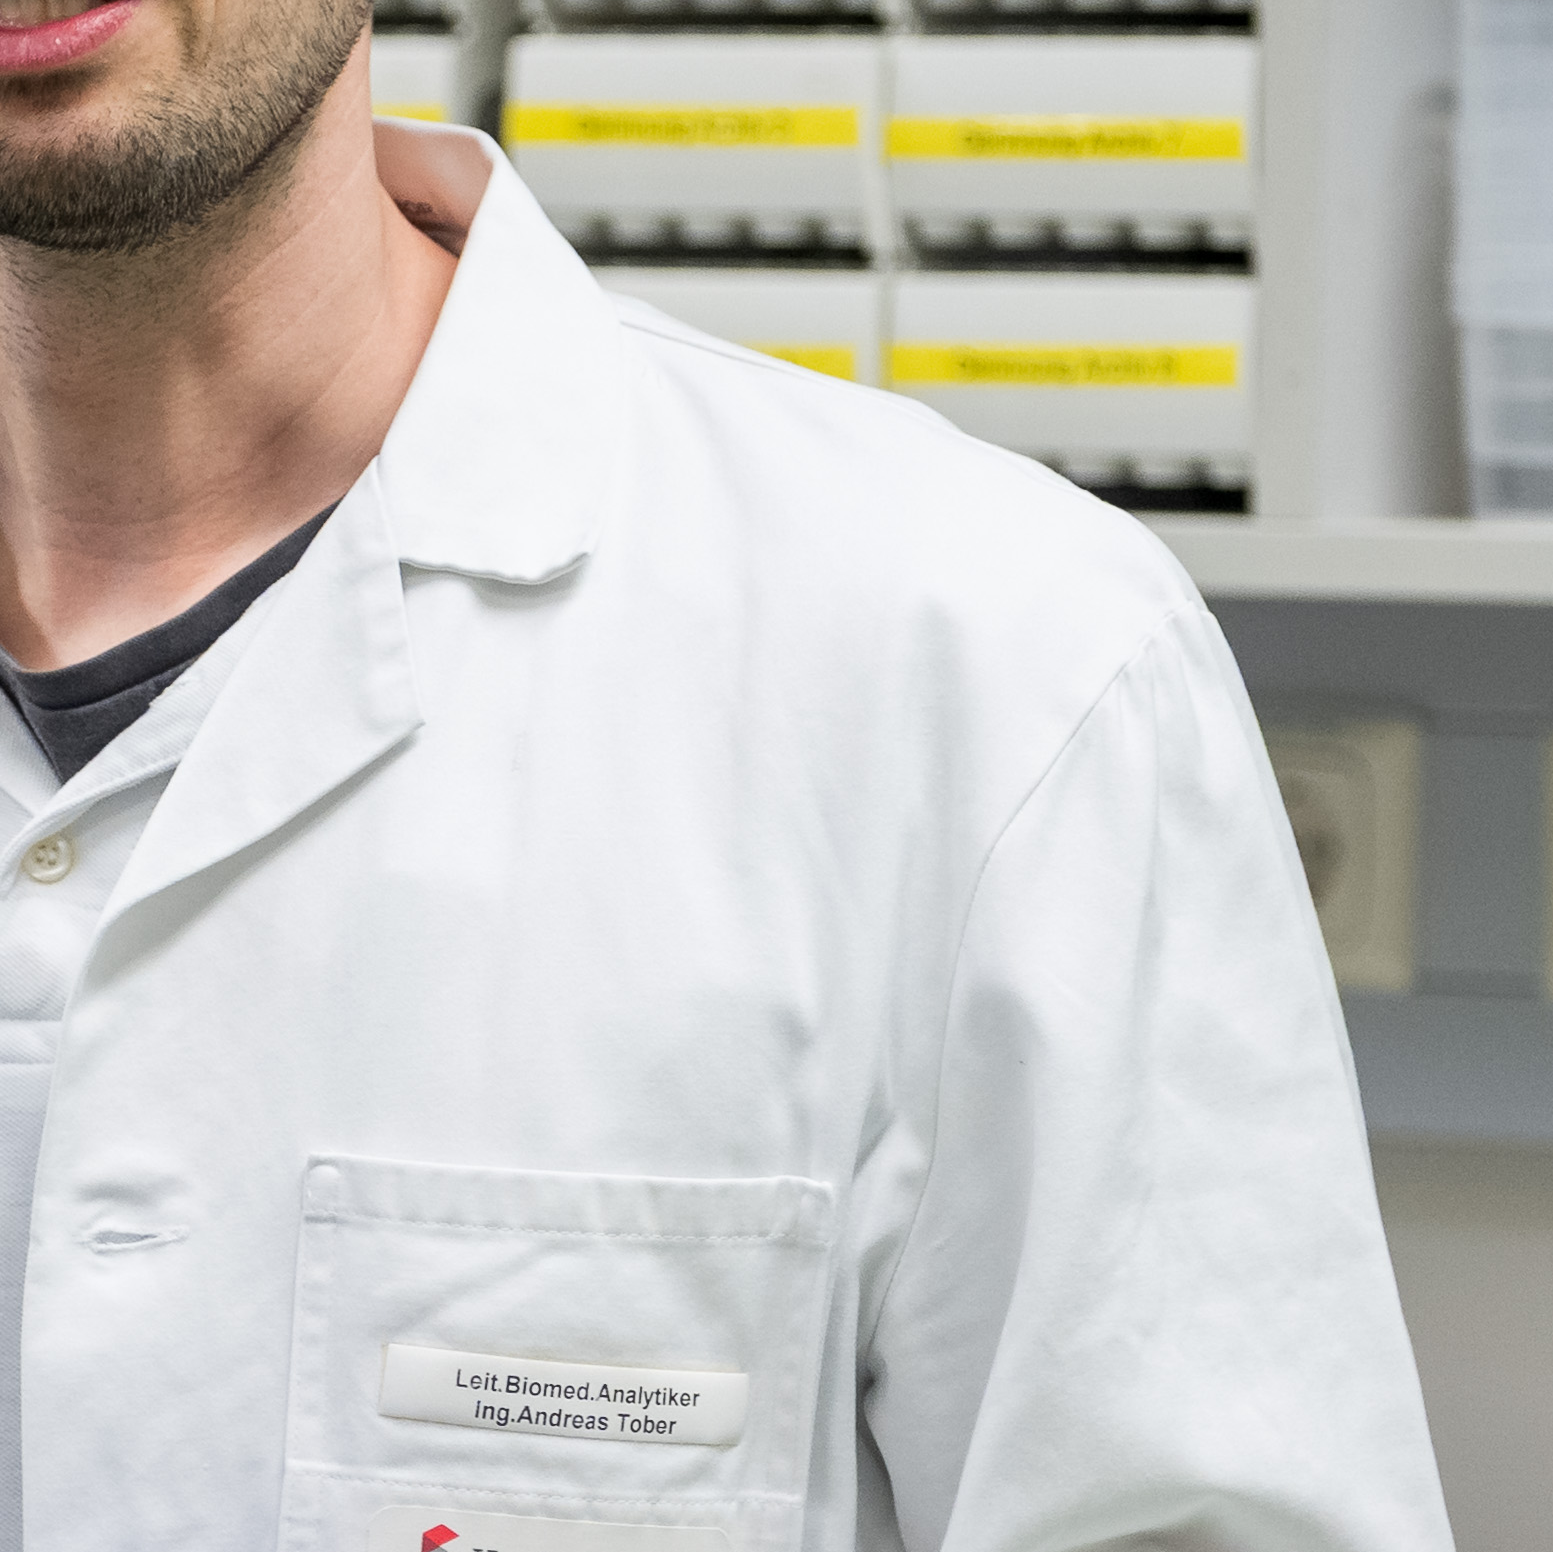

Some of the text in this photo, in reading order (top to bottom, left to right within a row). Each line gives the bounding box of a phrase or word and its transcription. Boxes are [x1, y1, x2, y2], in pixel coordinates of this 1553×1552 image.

[455, 1368, 701, 1410] Leit.Biomed.Analytiker
[474, 1399, 678, 1435] Ing.Andreas Tober
